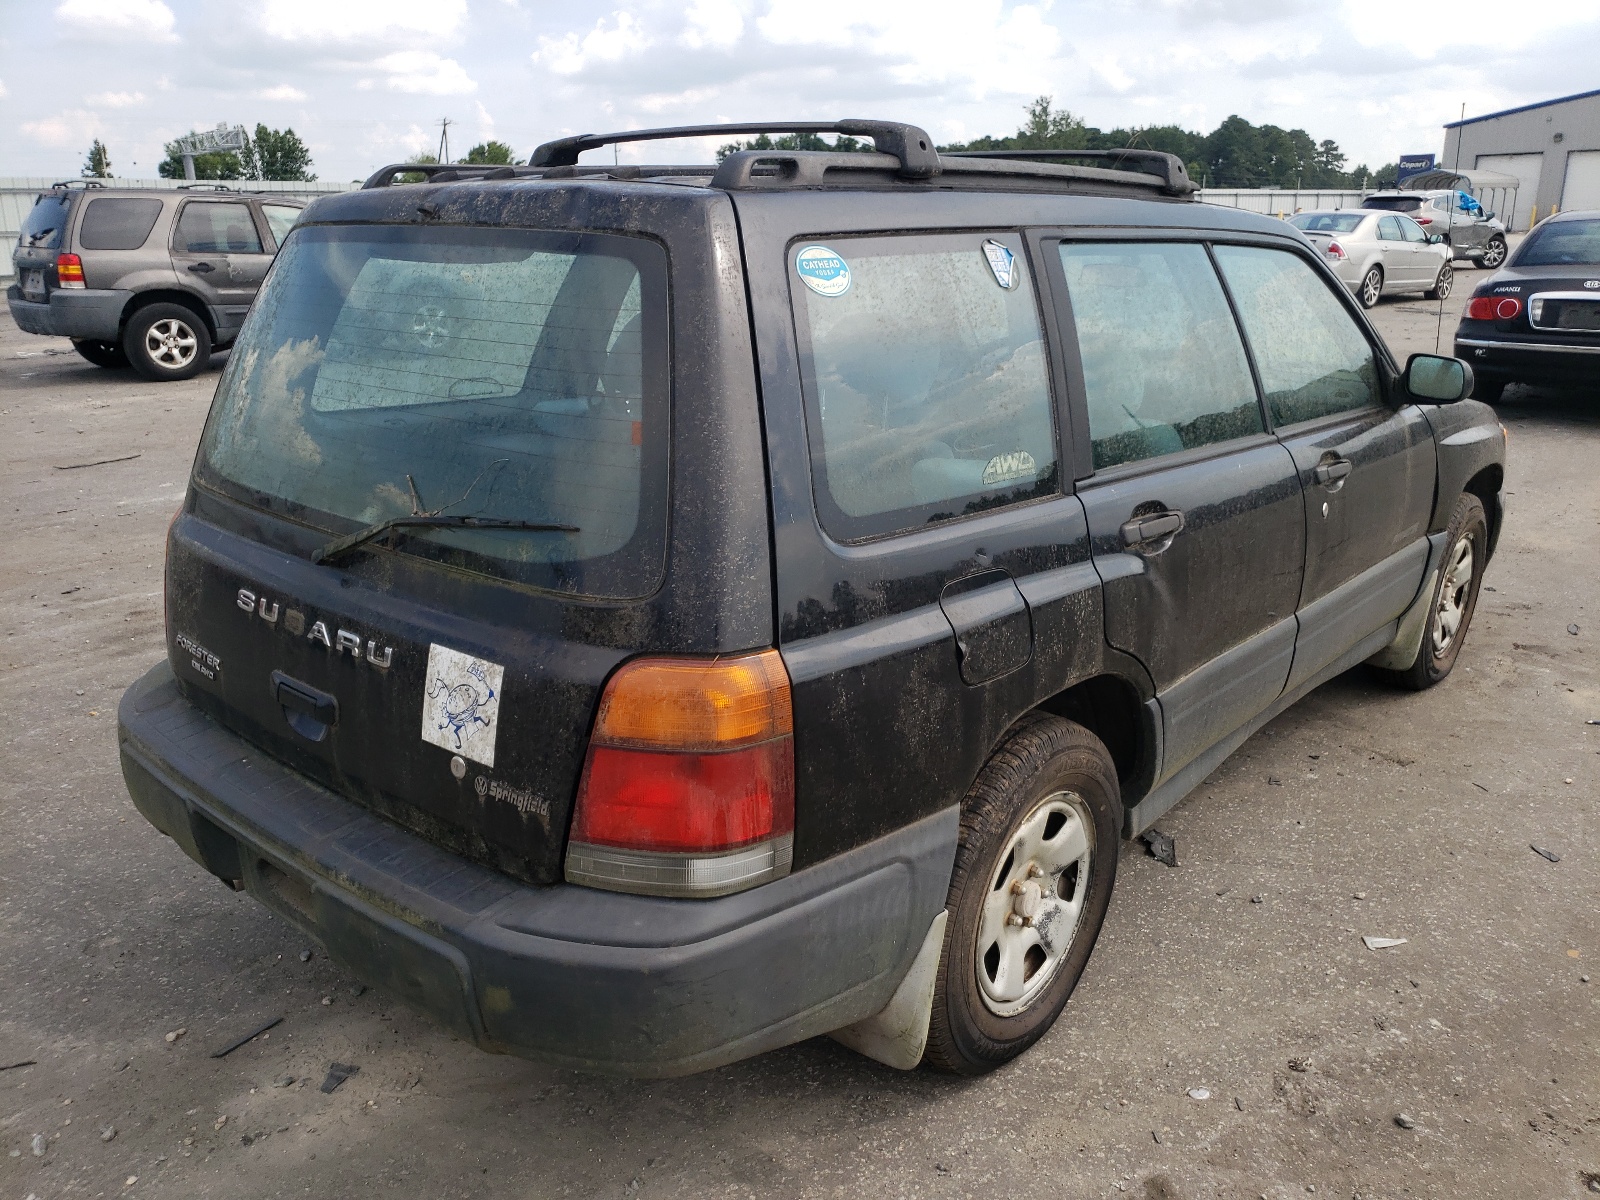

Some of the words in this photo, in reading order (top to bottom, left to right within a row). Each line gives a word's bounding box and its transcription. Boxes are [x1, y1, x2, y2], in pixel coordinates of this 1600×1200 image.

[1400, 160, 1427, 169] Copart
[802, 260, 841, 270] CATHEAD
[236, 589, 393, 669] SUARU
[176, 634, 220, 671] FORESTER
[489, 781, 550, 816] Springfield
